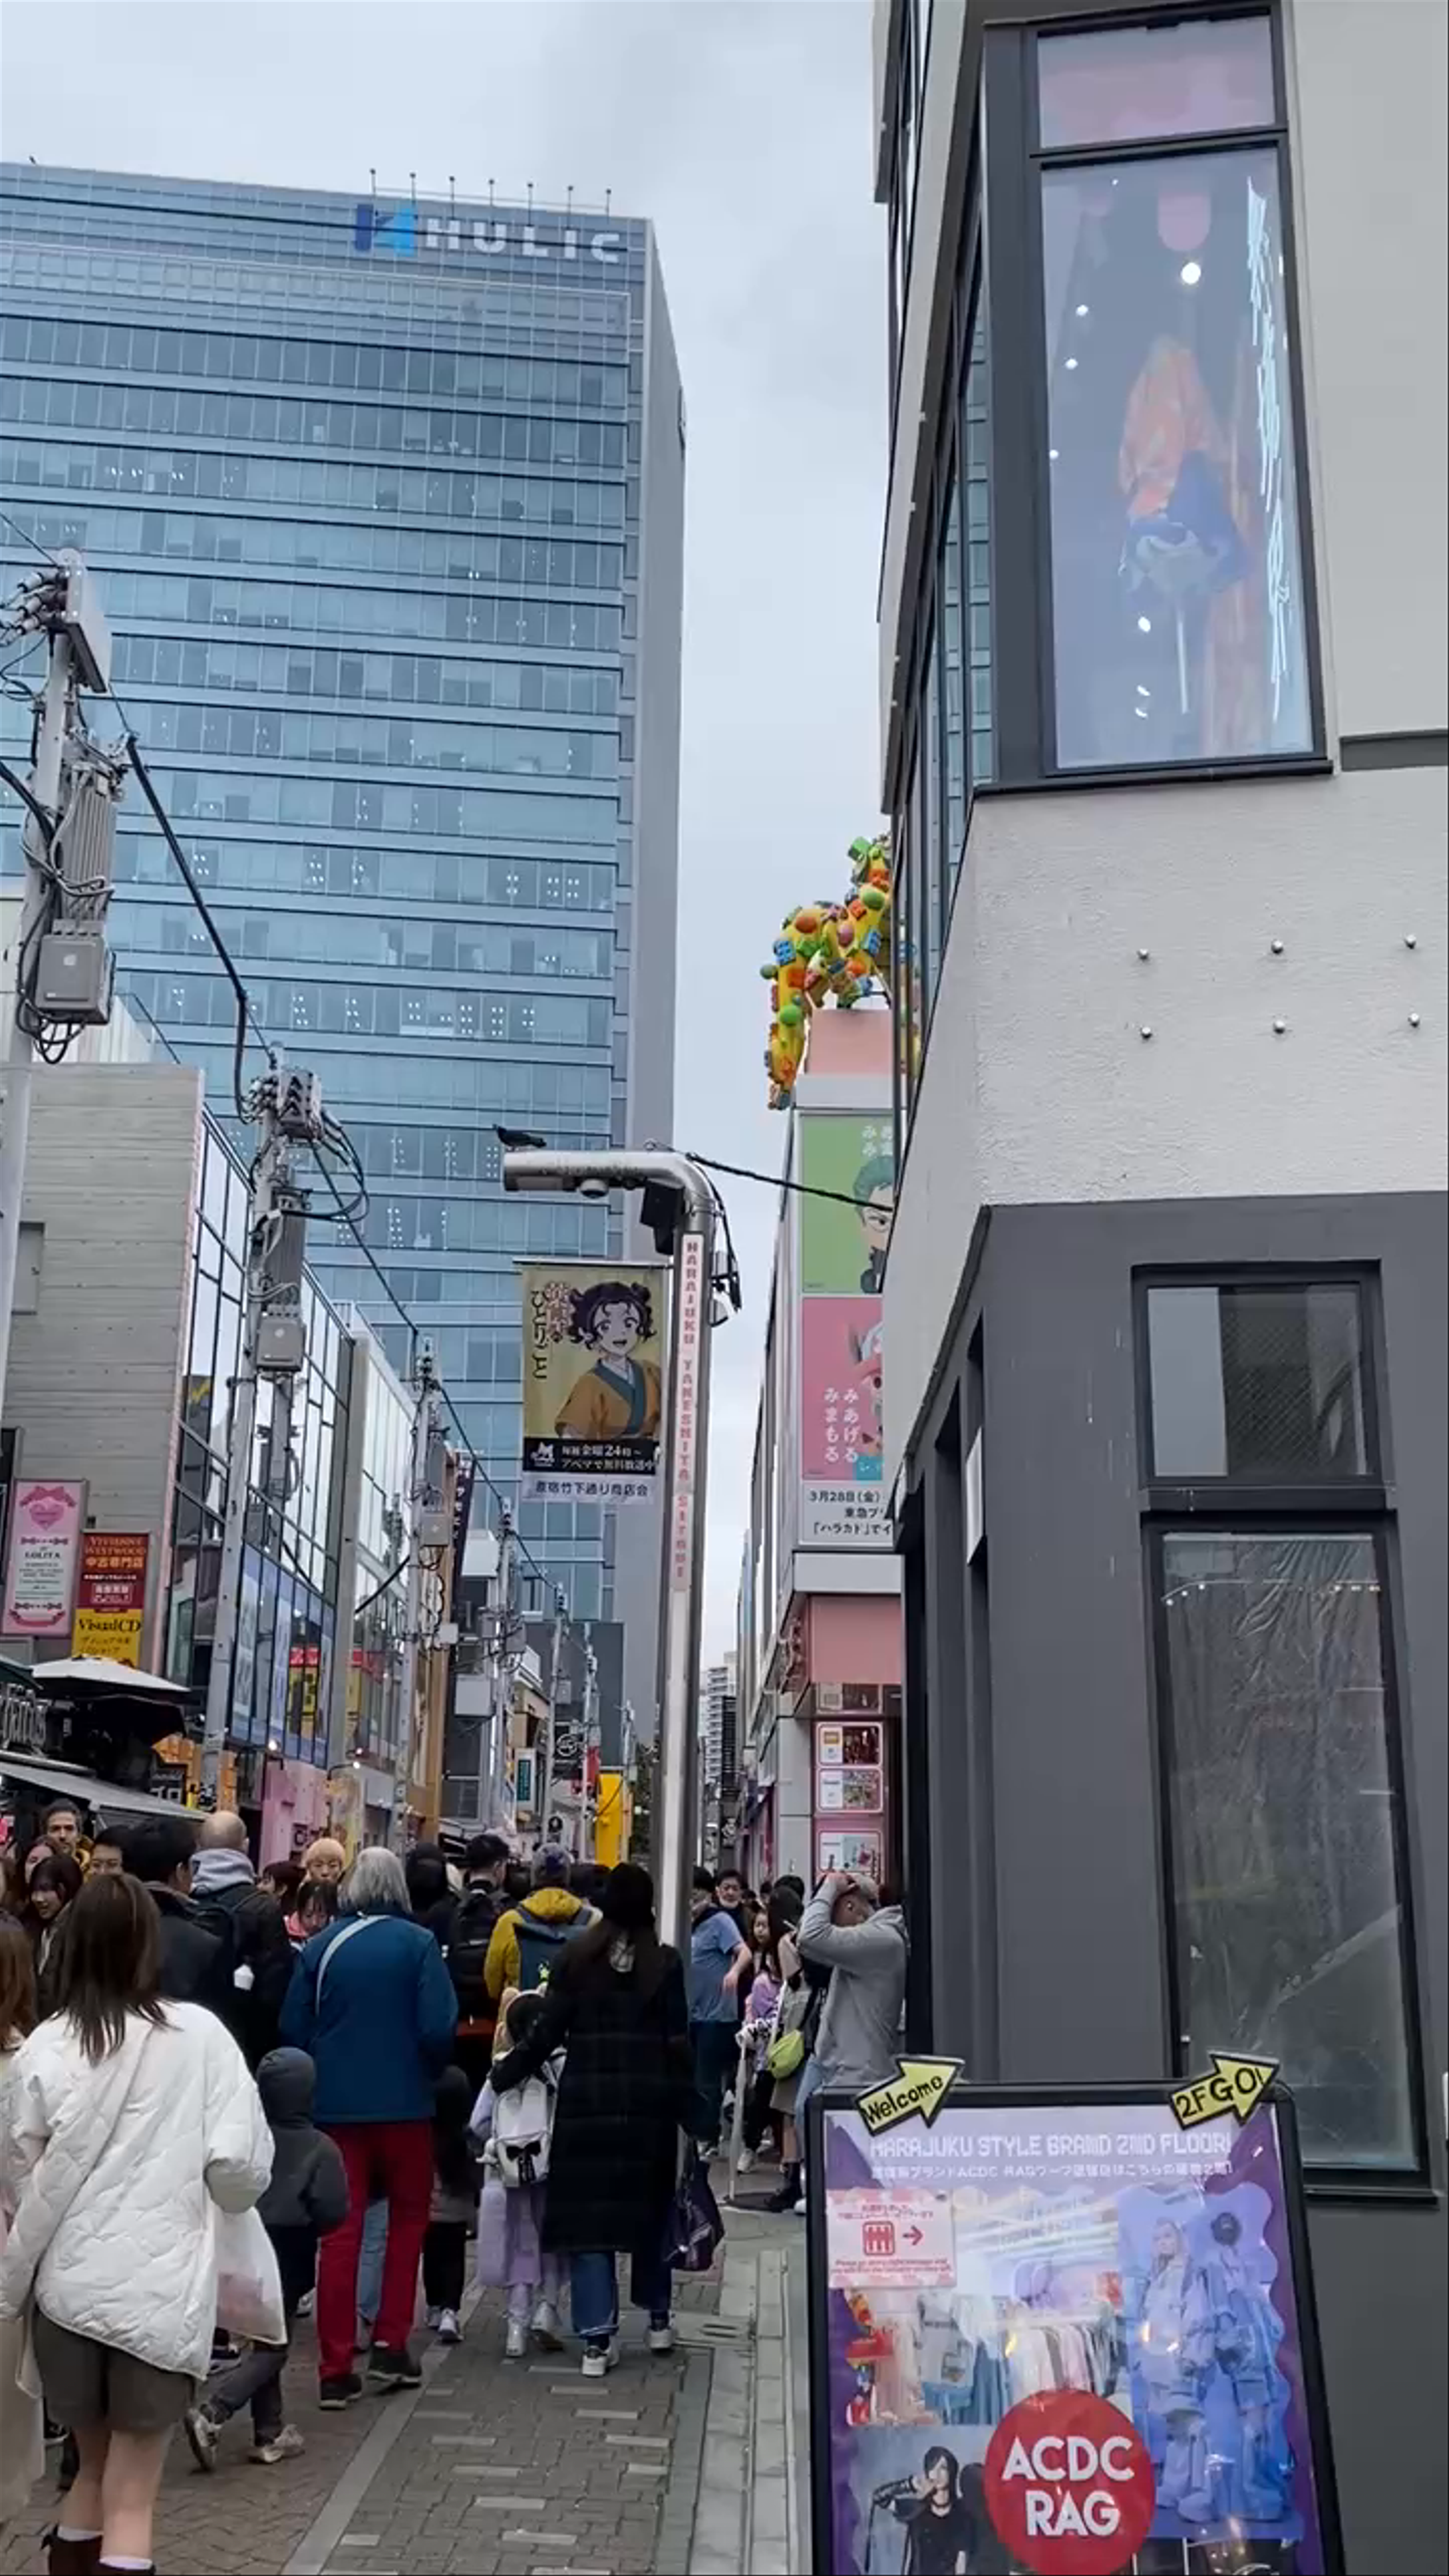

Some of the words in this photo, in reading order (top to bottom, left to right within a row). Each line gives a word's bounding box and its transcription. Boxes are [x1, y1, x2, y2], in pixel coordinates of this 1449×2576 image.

[426, 218, 621, 264] HULIC
[683, 1243, 698, 1344] HARAJUKU
[531, 1289, 547, 1379] ひとりごと
[870, 2137, 972, 2157] HARAJUKU
[978, 2135, 1042, 2157] STYLE
[1047, 2134, 1111, 2156] BRAND
[1116, 2134, 1155, 2155] 2ND
[1002, 2436, 1135, 2481] ACDC
[1026, 2490, 1121, 2536] RAG
